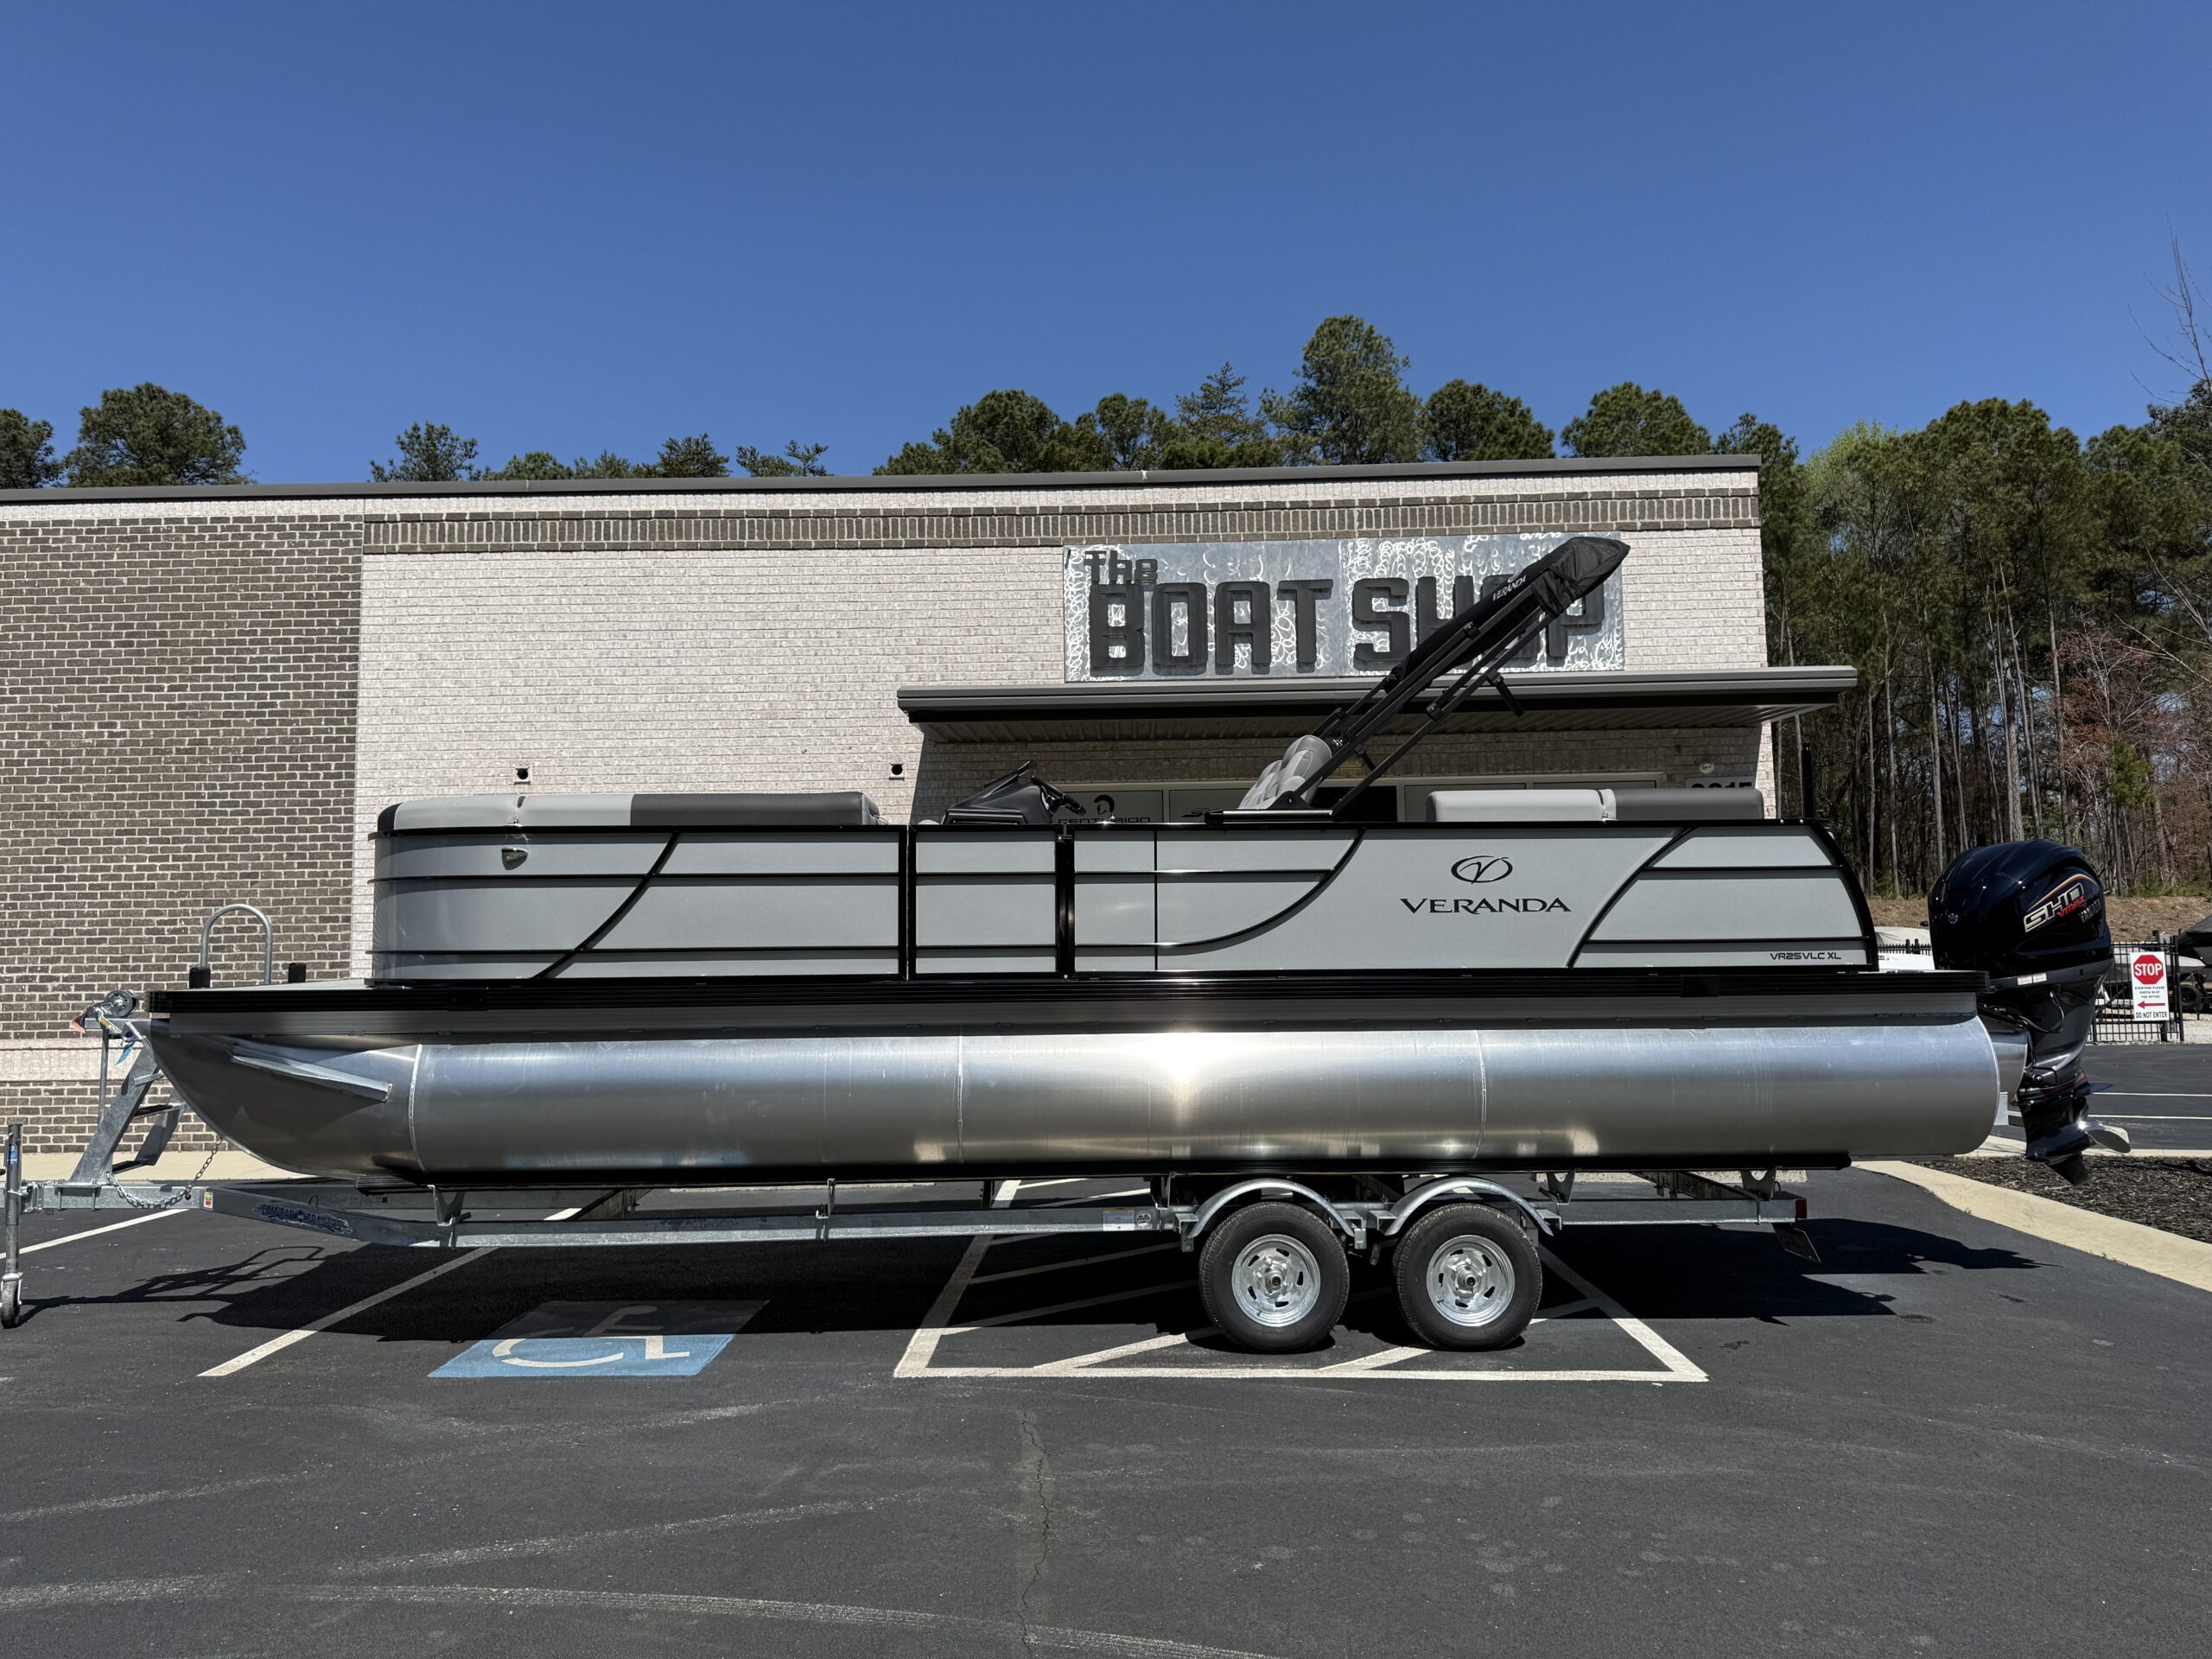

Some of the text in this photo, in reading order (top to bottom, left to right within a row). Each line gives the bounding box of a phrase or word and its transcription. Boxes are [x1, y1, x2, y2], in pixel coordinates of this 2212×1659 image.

[1090, 578, 1334, 669] BOAT
[1399, 897, 1572, 915] VERANDA
[2024, 882, 2085, 933] SHO
[1770, 951, 1842, 961] VR25VLC XL
[2135, 963, 2162, 976] STOP
